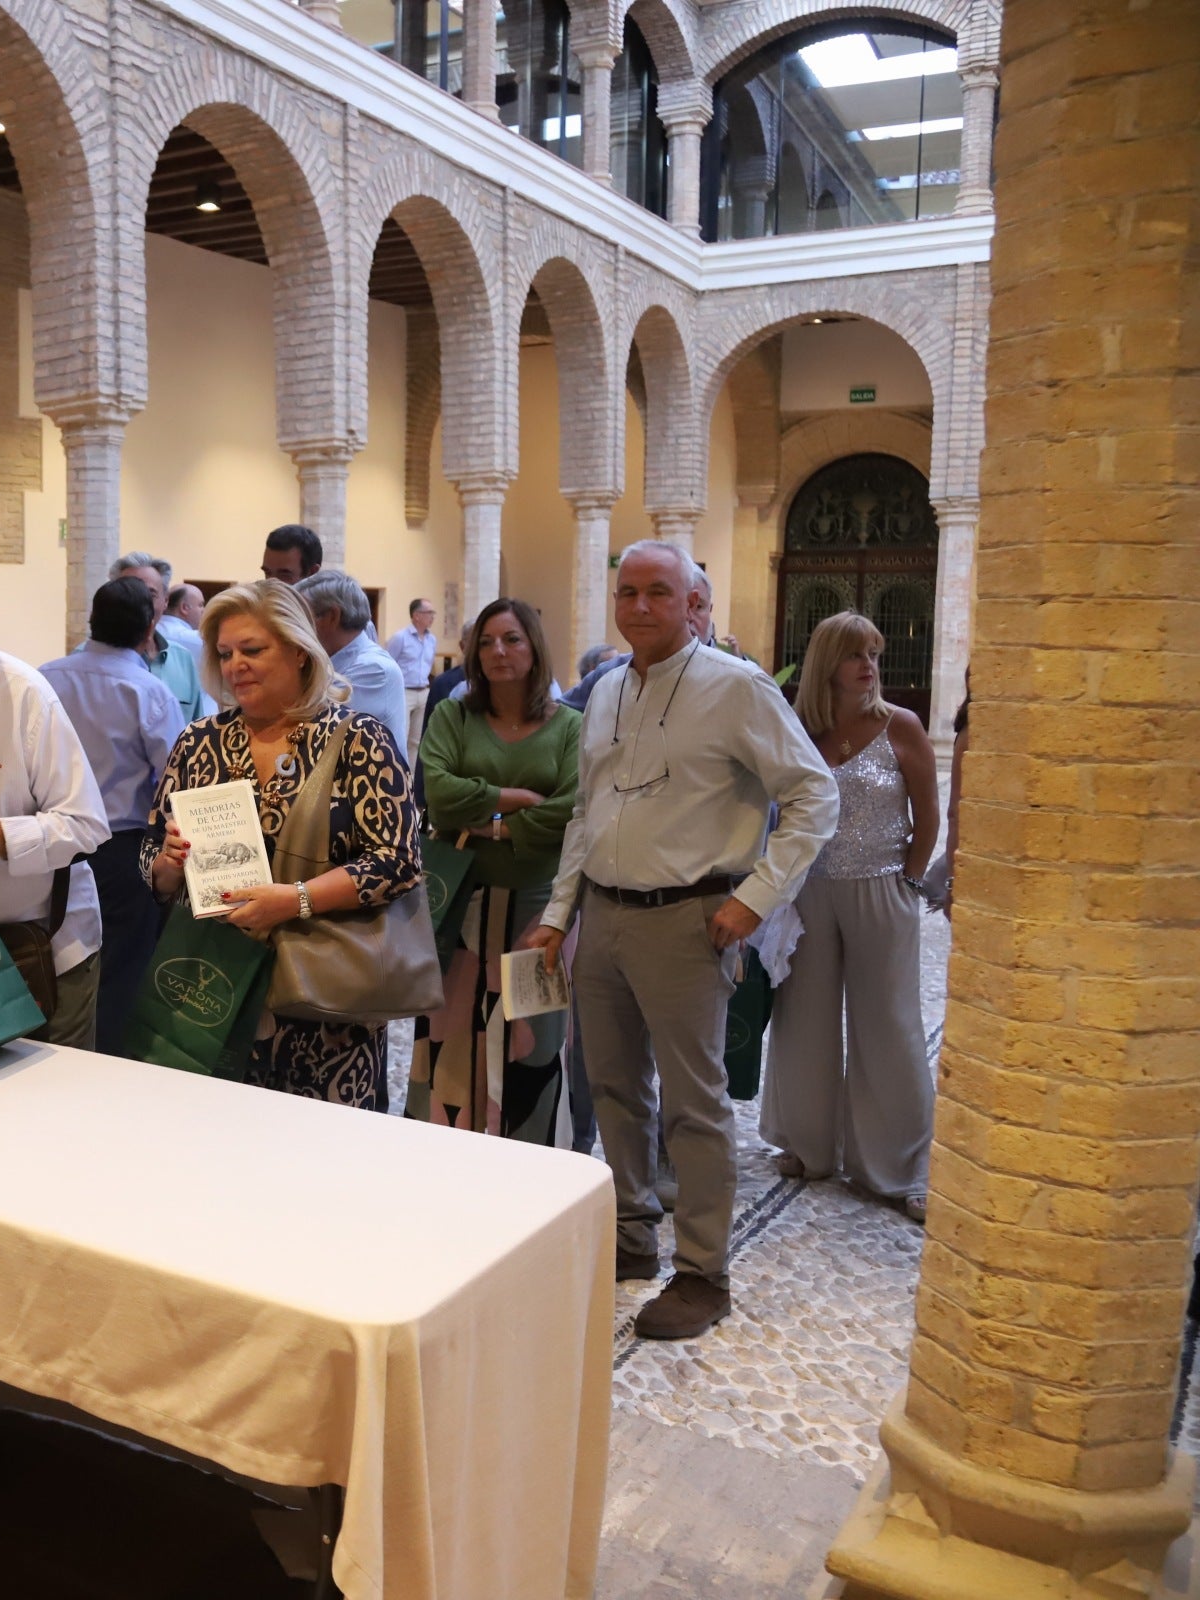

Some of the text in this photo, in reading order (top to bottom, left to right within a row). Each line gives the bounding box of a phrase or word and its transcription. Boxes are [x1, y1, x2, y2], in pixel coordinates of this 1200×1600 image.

[851, 392, 875, 401] SALIDA
[190, 801, 241, 816] MEMORIAS
[197, 812, 237, 825] DE CAZA
[214, 820, 246, 830] MAESTRO
[168, 977, 221, 1013] VARONA
